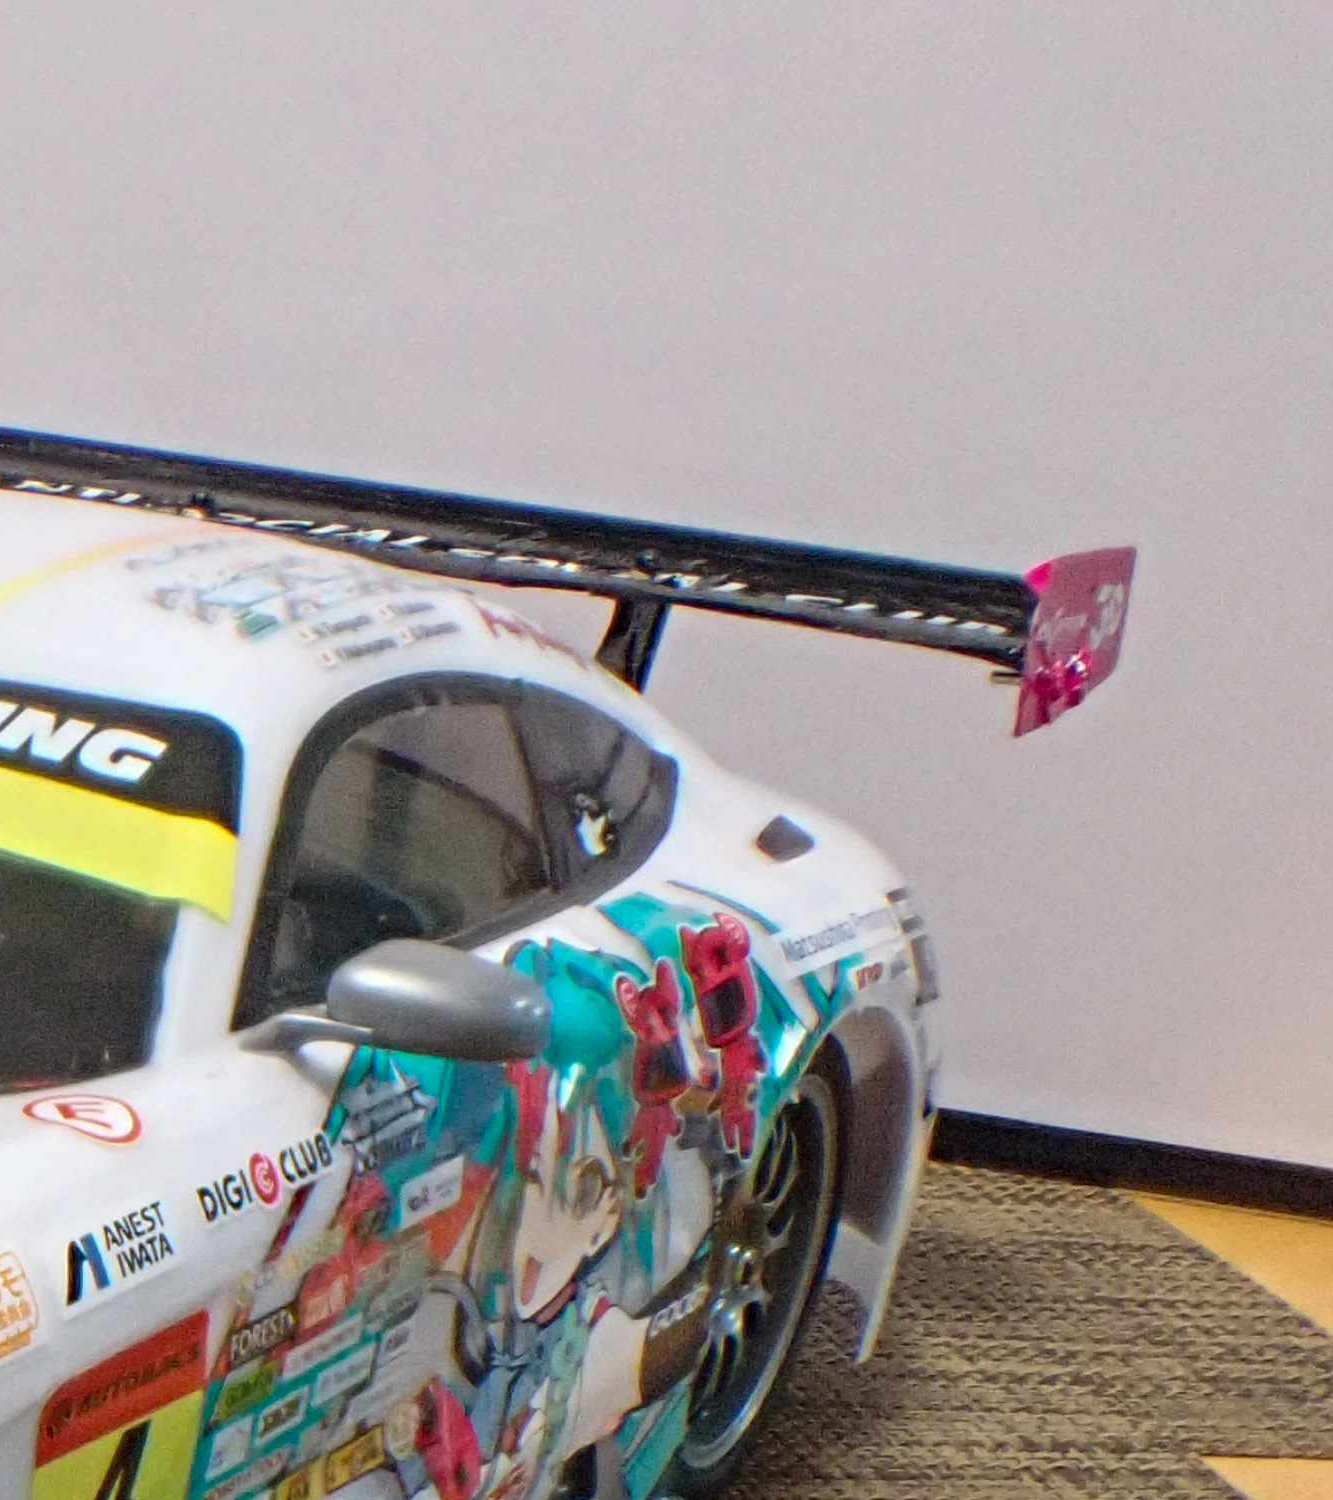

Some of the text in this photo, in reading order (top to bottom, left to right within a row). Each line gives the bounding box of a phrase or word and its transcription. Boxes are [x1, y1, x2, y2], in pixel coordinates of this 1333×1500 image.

[196, 1169, 253, 1224] DIGI
[278, 1131, 334, 1187] CLUB
[102, 1200, 165, 1249] ANEST
[116, 1233, 175, 1280] IWATA
